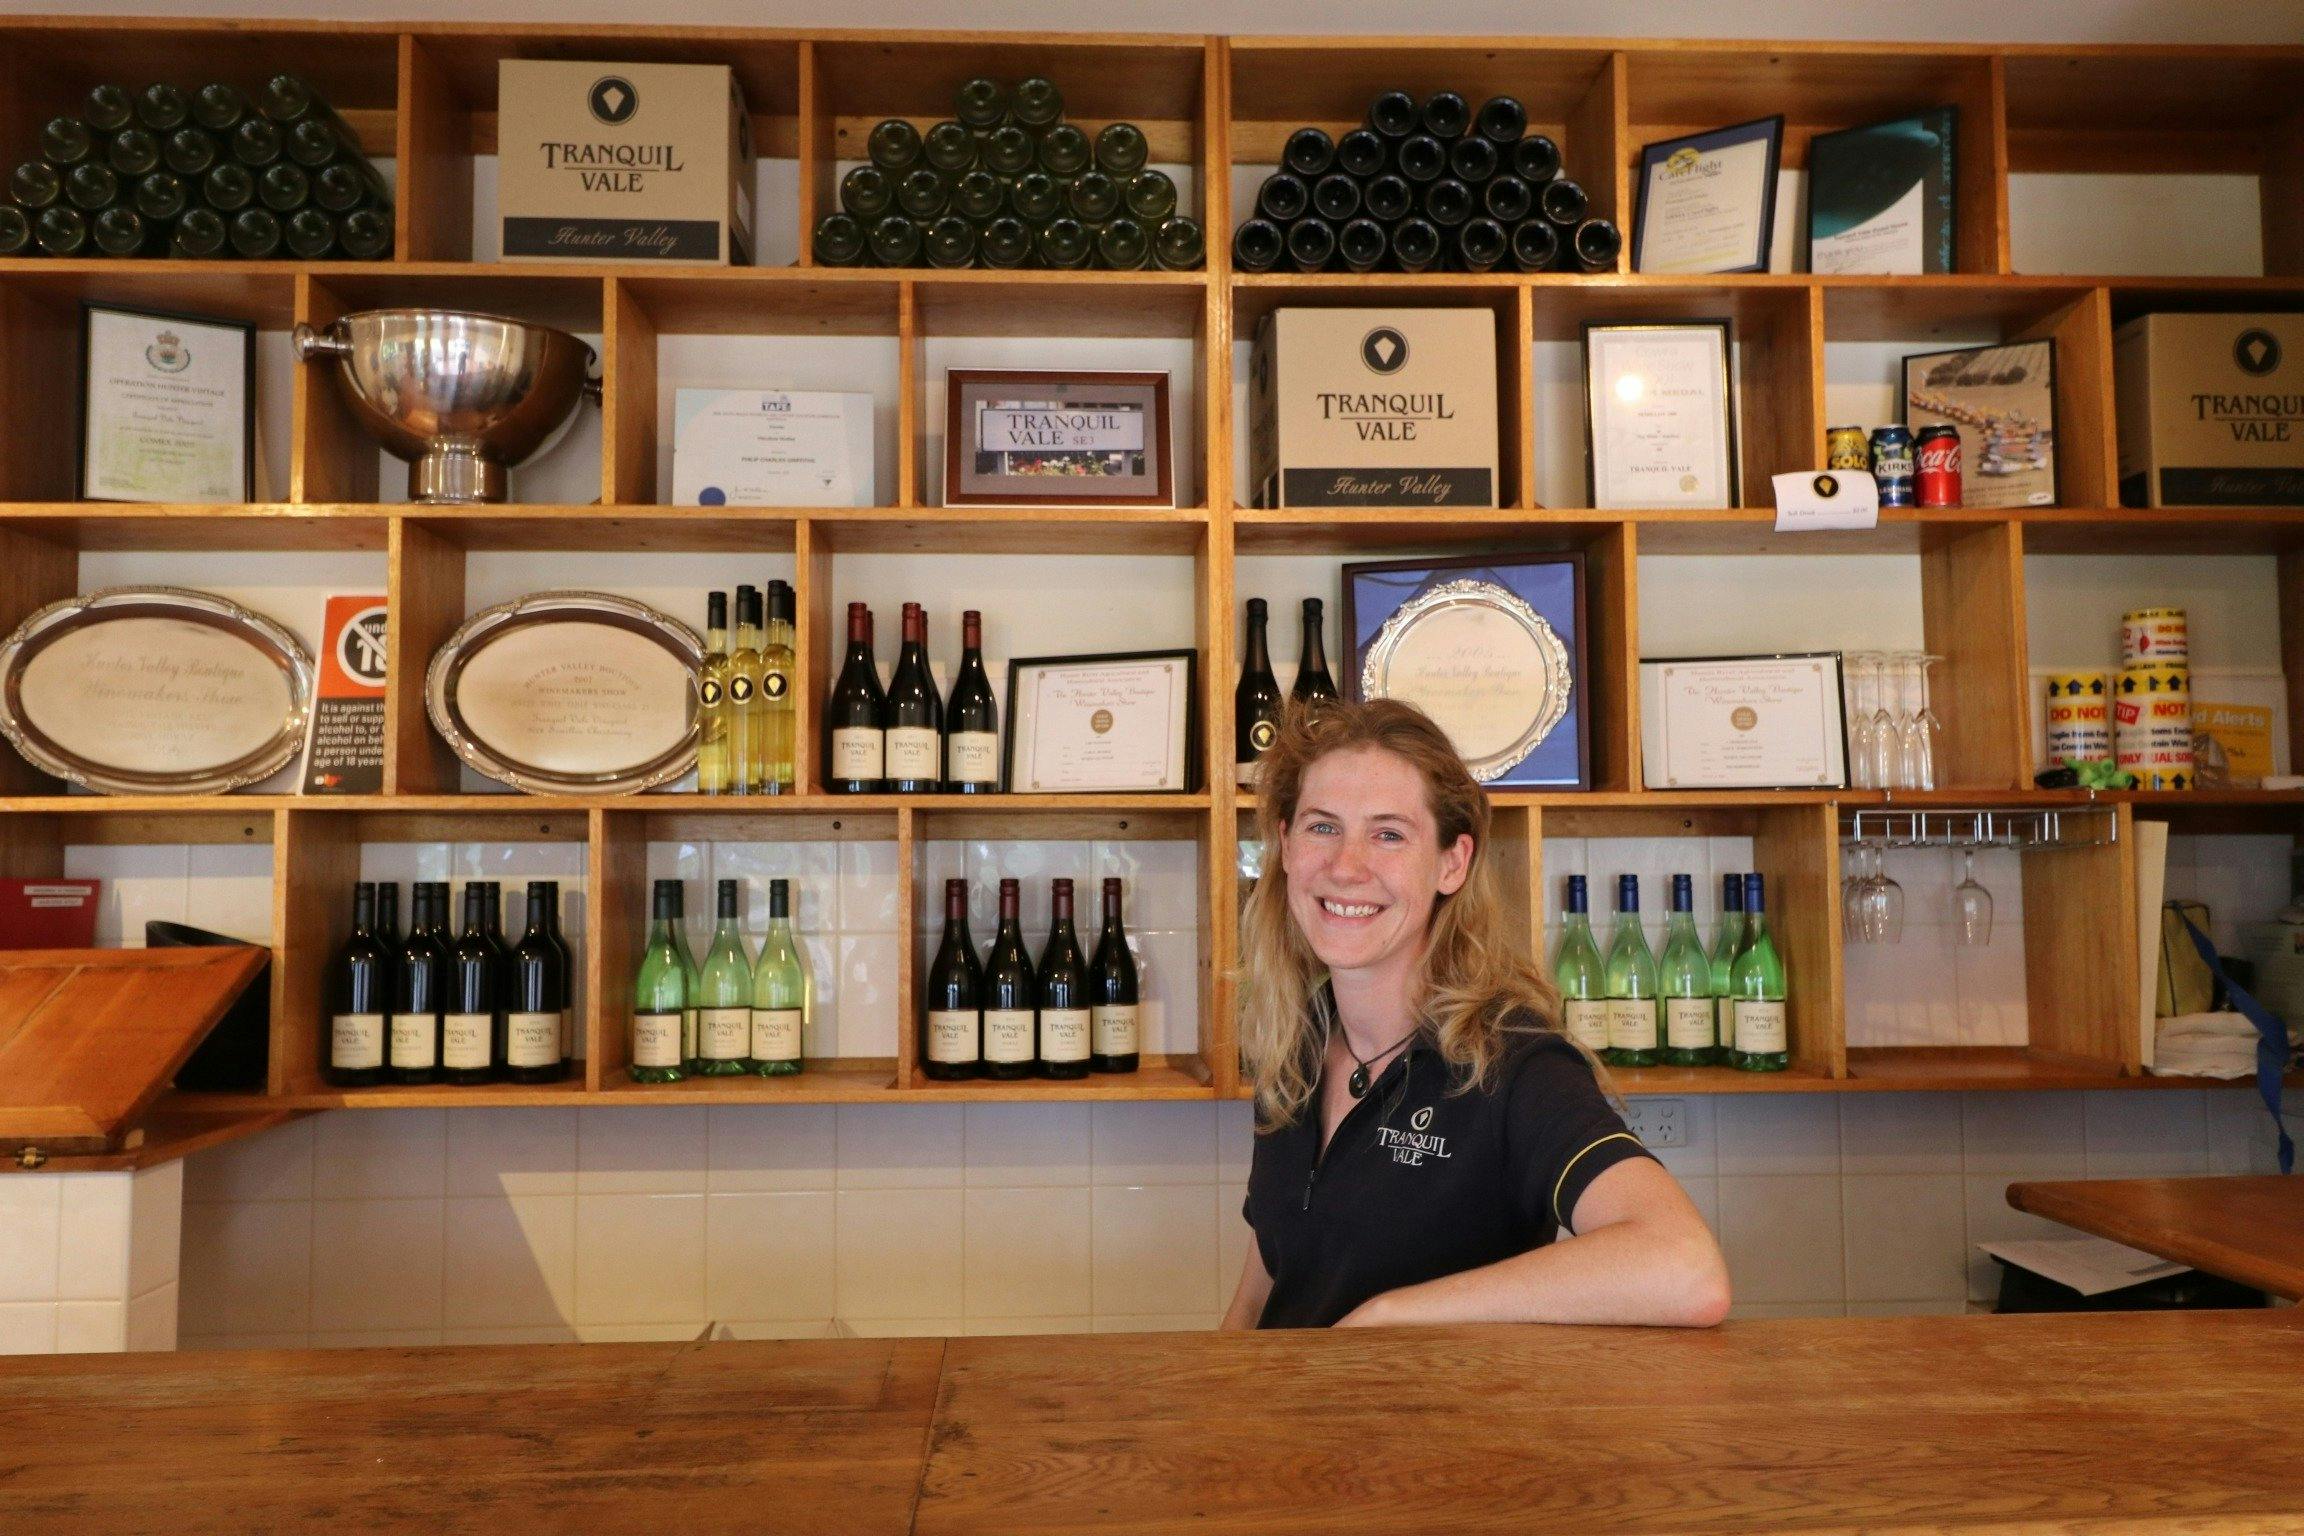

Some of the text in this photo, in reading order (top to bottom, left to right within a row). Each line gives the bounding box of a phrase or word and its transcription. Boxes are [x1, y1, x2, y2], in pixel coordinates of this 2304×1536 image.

[540, 142, 685, 172] TRANQUIL
[581, 172, 644, 193] VALE
[548, 225, 680, 256] Hunter Valley
[1316, 393, 1456, 420] TRANQUIL
[1007, 414, 1120, 431] TRANQUIL
[1009, 430, 1094, 445] VALE SE3
[1356, 421, 1417, 441] VALE
[2230, 422, 2291, 442] VALE
[1327, 474, 1452, 504] Hunter Valley
[322, 703, 329, 713] It
[330, 703, 338, 713] is
[340, 703, 375, 715] against
[2153, 703, 2186, 717] NOT
[320, 714, 329, 723] to
[331, 714, 348, 724] sell
[319, 725, 354, 735] alcohol
[317, 734, 351, 745] alcohol
[354, 736, 365, 745] on
[323, 748, 357, 759] person
[333, 757, 344, 767] of
[934, 1024, 969, 1032] TRANQUIL
[992, 1024, 1027, 1032] TRANQUIL
[1050, 1023, 1085, 1032] TRANQUIL
[1102, 1018, 1136, 1026] TRANQUIL
[1377, 1126, 1452, 1159] TRANQUIL
[1392, 1148, 1423, 1166] VALE
